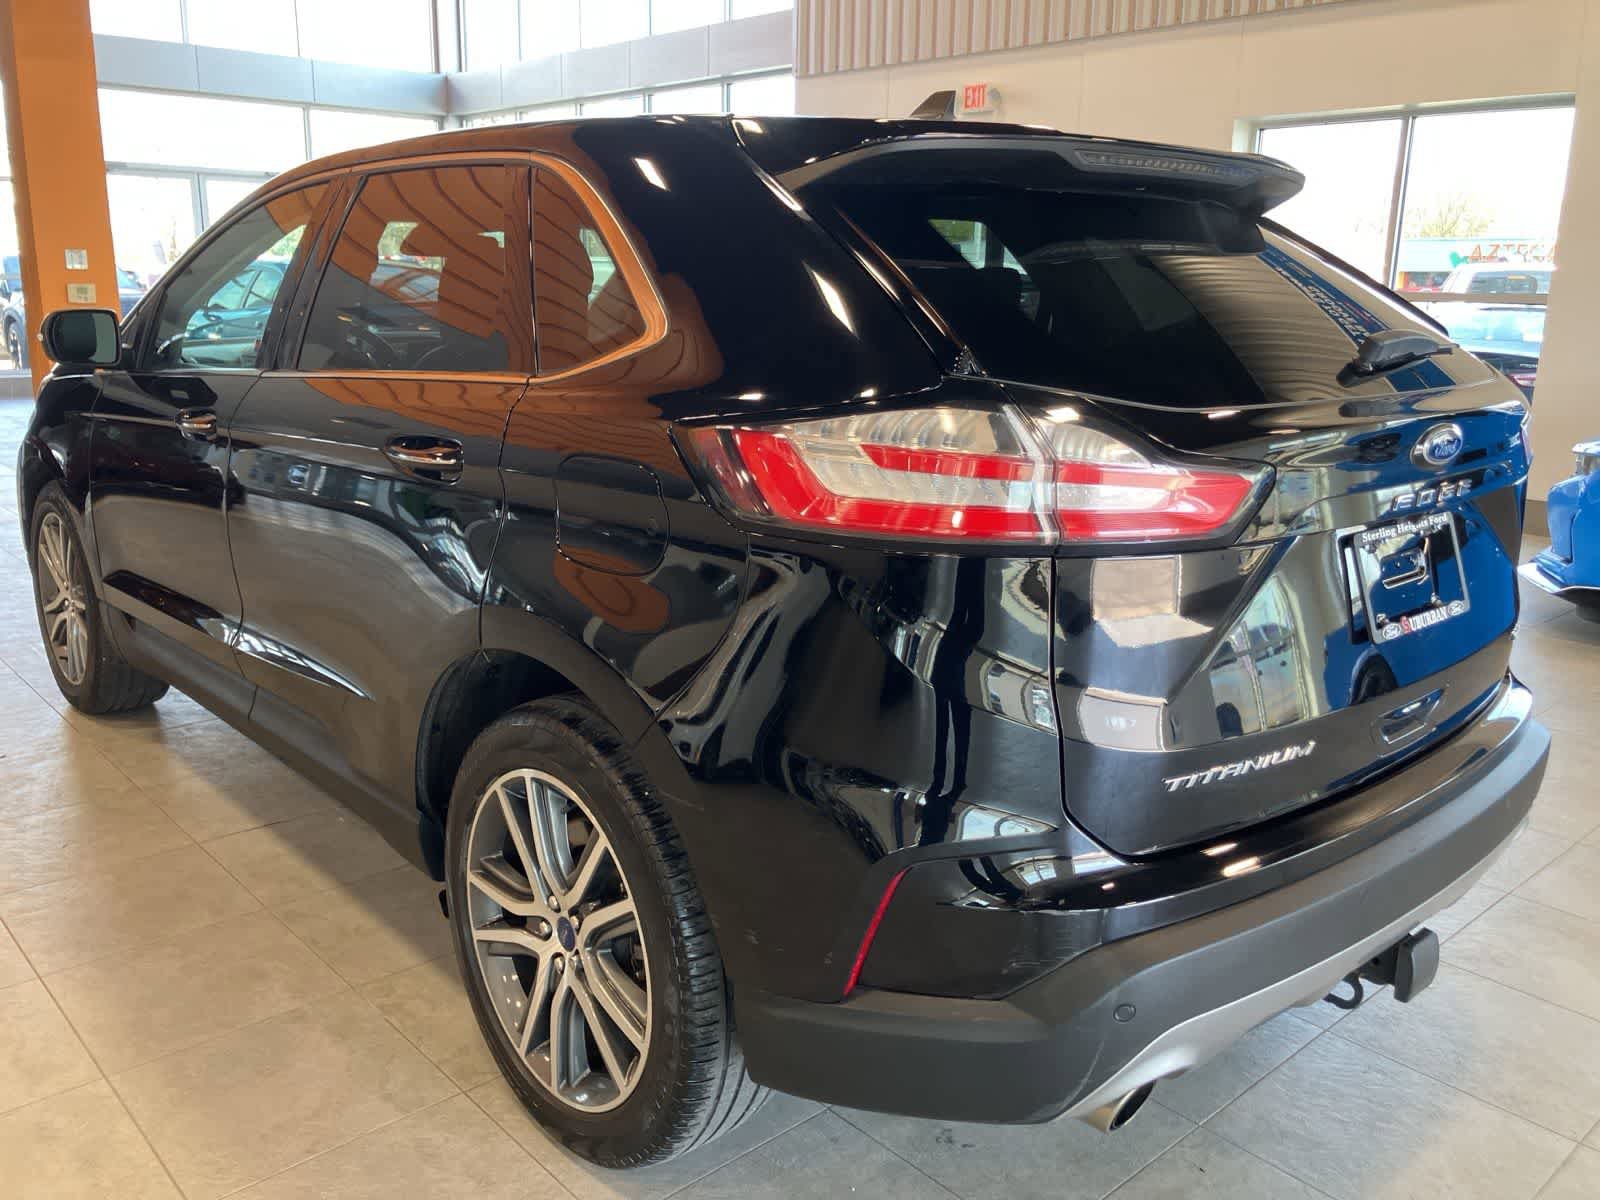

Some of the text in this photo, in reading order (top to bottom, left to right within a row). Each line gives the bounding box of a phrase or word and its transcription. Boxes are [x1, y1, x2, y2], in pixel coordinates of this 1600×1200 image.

[964, 84, 987, 108] EXIT
[1362, 527, 1397, 542] Sterling
[1428, 513, 1448, 525] Ford
[1401, 606, 1448, 634] SUBURBAN
[1163, 740, 1316, 792] TITANIUM
